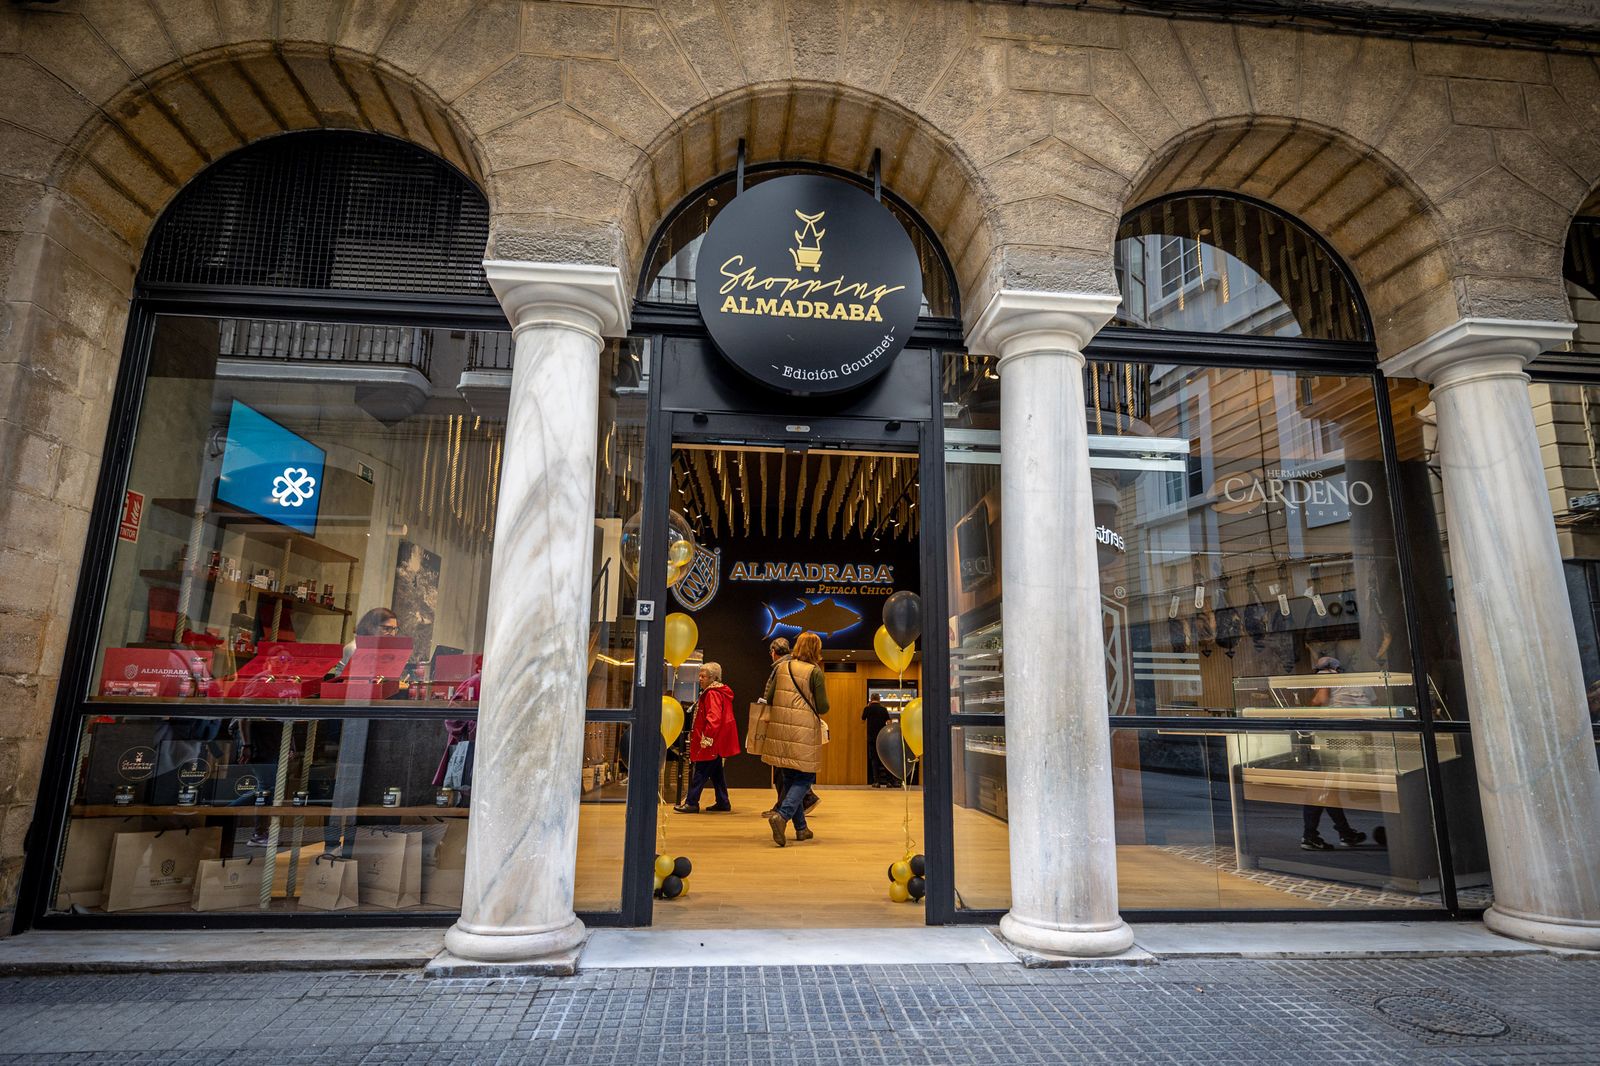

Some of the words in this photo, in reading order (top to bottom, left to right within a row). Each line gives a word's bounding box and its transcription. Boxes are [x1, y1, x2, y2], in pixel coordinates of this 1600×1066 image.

[719, 254, 905, 304] Shopping
[782, 365, 839, 381] Edición
[840, 333, 895, 376] Gourmet
[1266, 469, 1323, 479] HERMANOS
[729, 561, 894, 583] ALMADRABA
